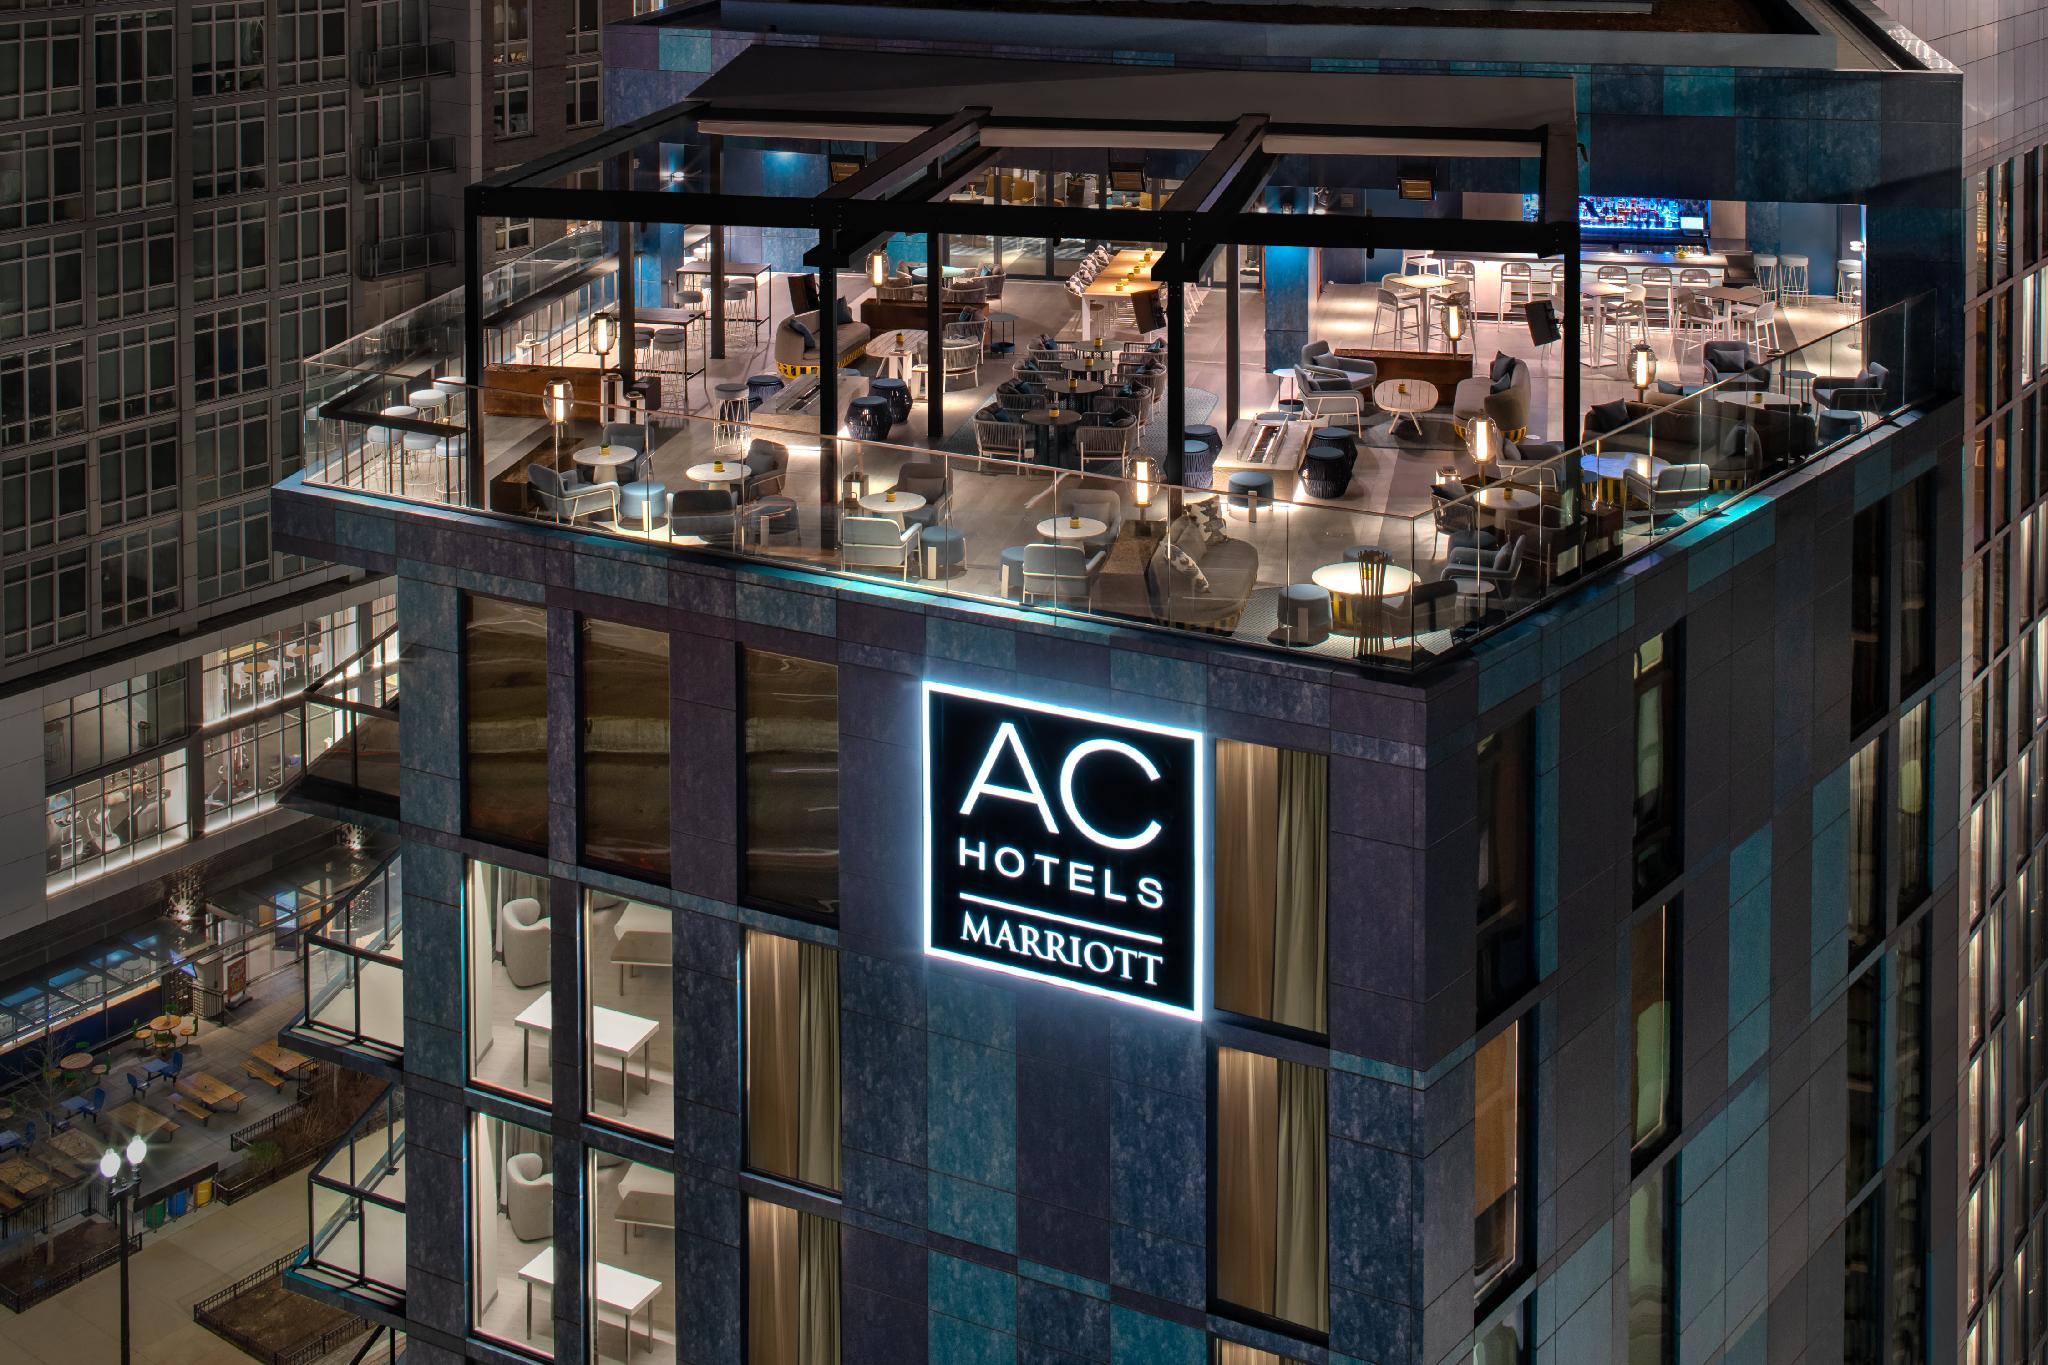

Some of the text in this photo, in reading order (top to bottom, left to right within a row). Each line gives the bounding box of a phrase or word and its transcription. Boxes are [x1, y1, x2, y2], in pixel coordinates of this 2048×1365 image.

[959, 722, 1162, 850] AC
[959, 837, 1164, 909] HOTELS
[960, 910, 1164, 986] MARRIOTT
